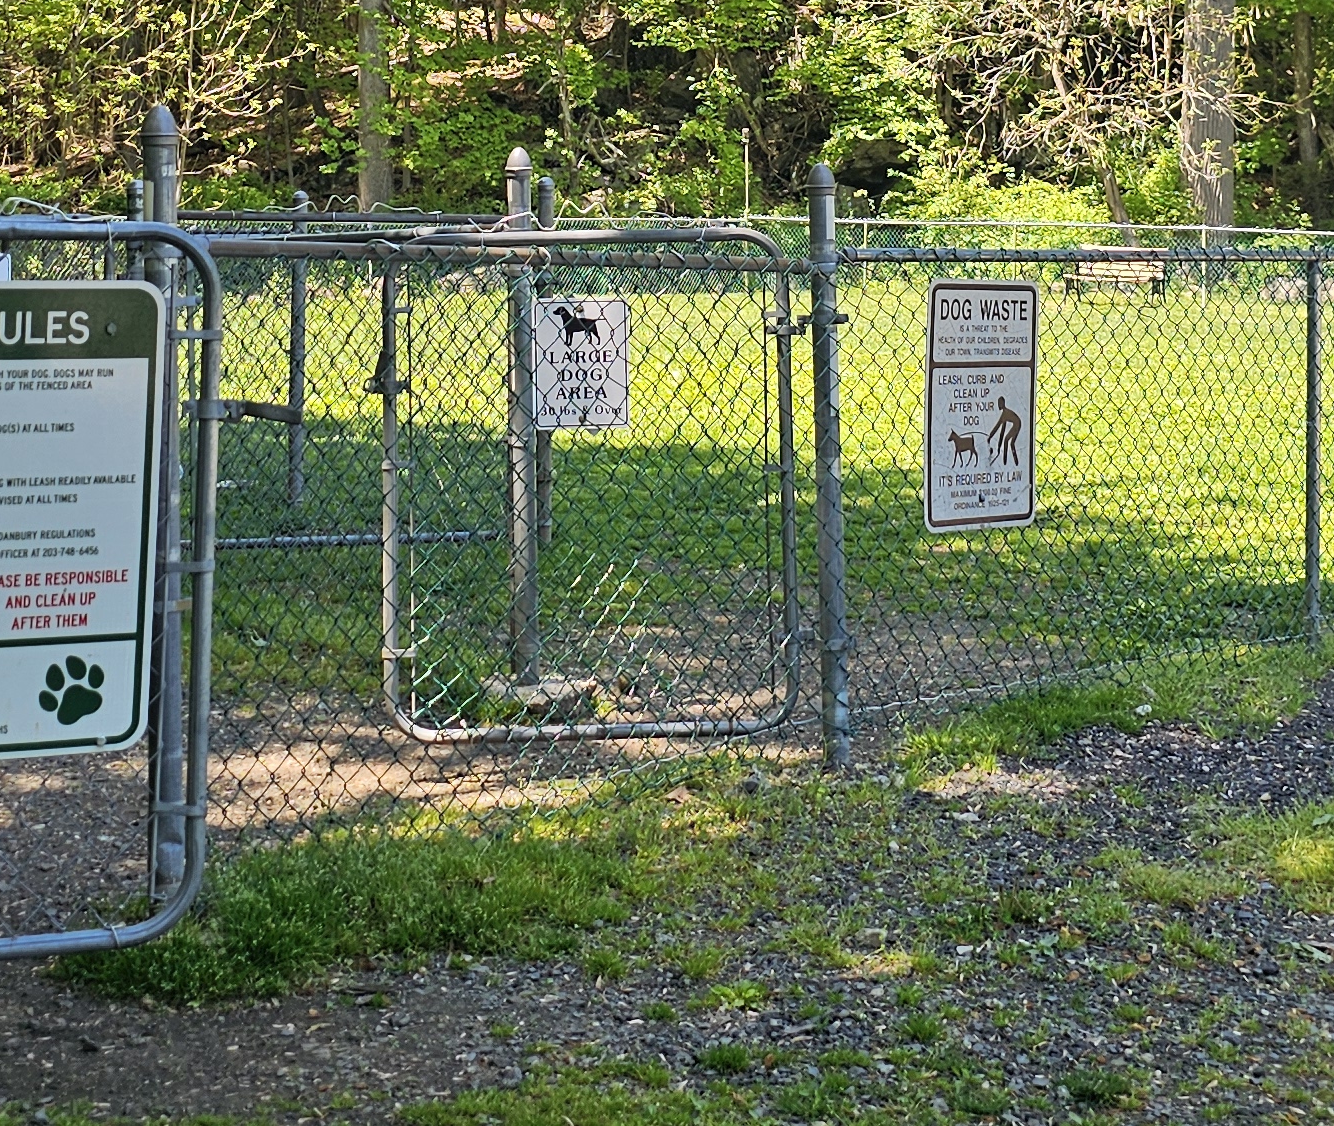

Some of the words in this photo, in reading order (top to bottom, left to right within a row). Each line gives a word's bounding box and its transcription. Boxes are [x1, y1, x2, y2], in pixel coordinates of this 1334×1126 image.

[941, 299, 972, 320] DOG
[980, 299, 1027, 321] WASTE
[959, 325, 964, 333] IS
[958, 336, 964, 344] OF
[966, 336, 975, 344] OUR
[550, 350, 613, 363] LARGE
[6, 369, 28, 378] YOUR
[53, 368, 75, 378] DOGS
[78, 369, 93, 377] MAY
[97, 368, 113, 377] RUN
[561, 368, 602, 381] DOG
[967, 374, 986, 384] CURB
[990, 374, 1004, 384] AND
[4, 381, 15, 391] OF
[18, 381, 33, 390] THE
[36, 380, 68, 390] FENCED
[70, 380, 92, 389] AREA
[556, 386, 607, 400] AREA
[954, 389, 977, 398] CLEAN
[981, 388, 990, 397] UP
[560, 406, 577, 415] lbs
[949, 402, 972, 412] AFTER
[975, 402, 994, 411] YOUR
[964, 416, 979, 425] DOG
[956, 473, 991, 486] REQUIRED
[995, 472, 1004, 483] BY
[1007, 471, 1022, 482] LAW
[951, 490, 977, 498] MAXIMUM
[39, 528, 95, 539] REGULATIONS
[30, 547, 40, 557] AT
[25, 573, 41, 586] BE
[45, 569, 128, 586] RESPONSIBLE
[5, 595, 30, 609] AND
[35, 593, 75, 607] CLEAN
[79, 591, 95, 605] UP
[11, 615, 51, 630] AFTER
[55, 613, 87, 627] THEM
